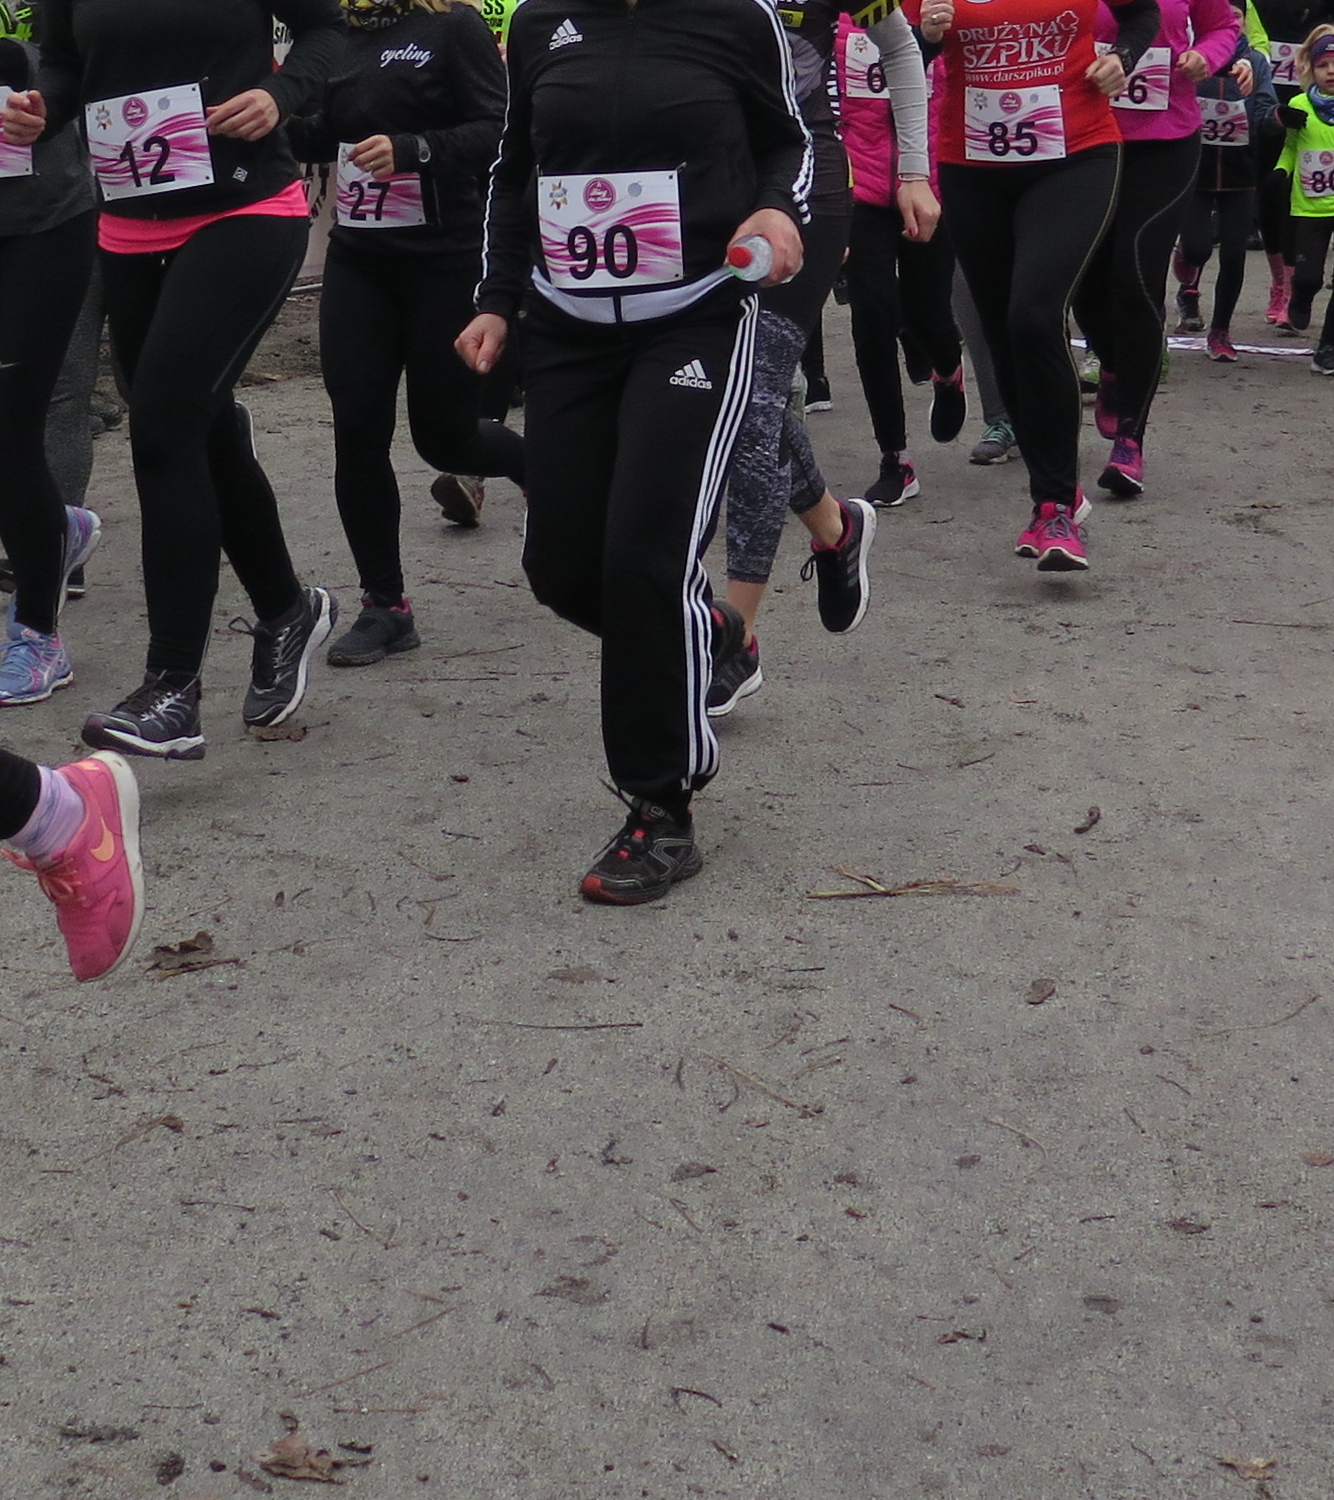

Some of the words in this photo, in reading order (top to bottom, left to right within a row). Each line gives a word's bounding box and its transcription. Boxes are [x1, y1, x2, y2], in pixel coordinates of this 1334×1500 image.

[548, 34, 584, 51] adidas
[957, 21, 1059, 43] DRUŻYNA
[379, 43, 435, 68] cycling
[962, 34, 1077, 69] SZPIKU
[988, 122, 1038, 157] 85
[1203, 119, 1236, 143] 32
[119, 135, 175, 188] 12
[348, 180, 391, 222] 27
[567, 224, 638, 281] 90
[669, 376, 713, 390] adidas
